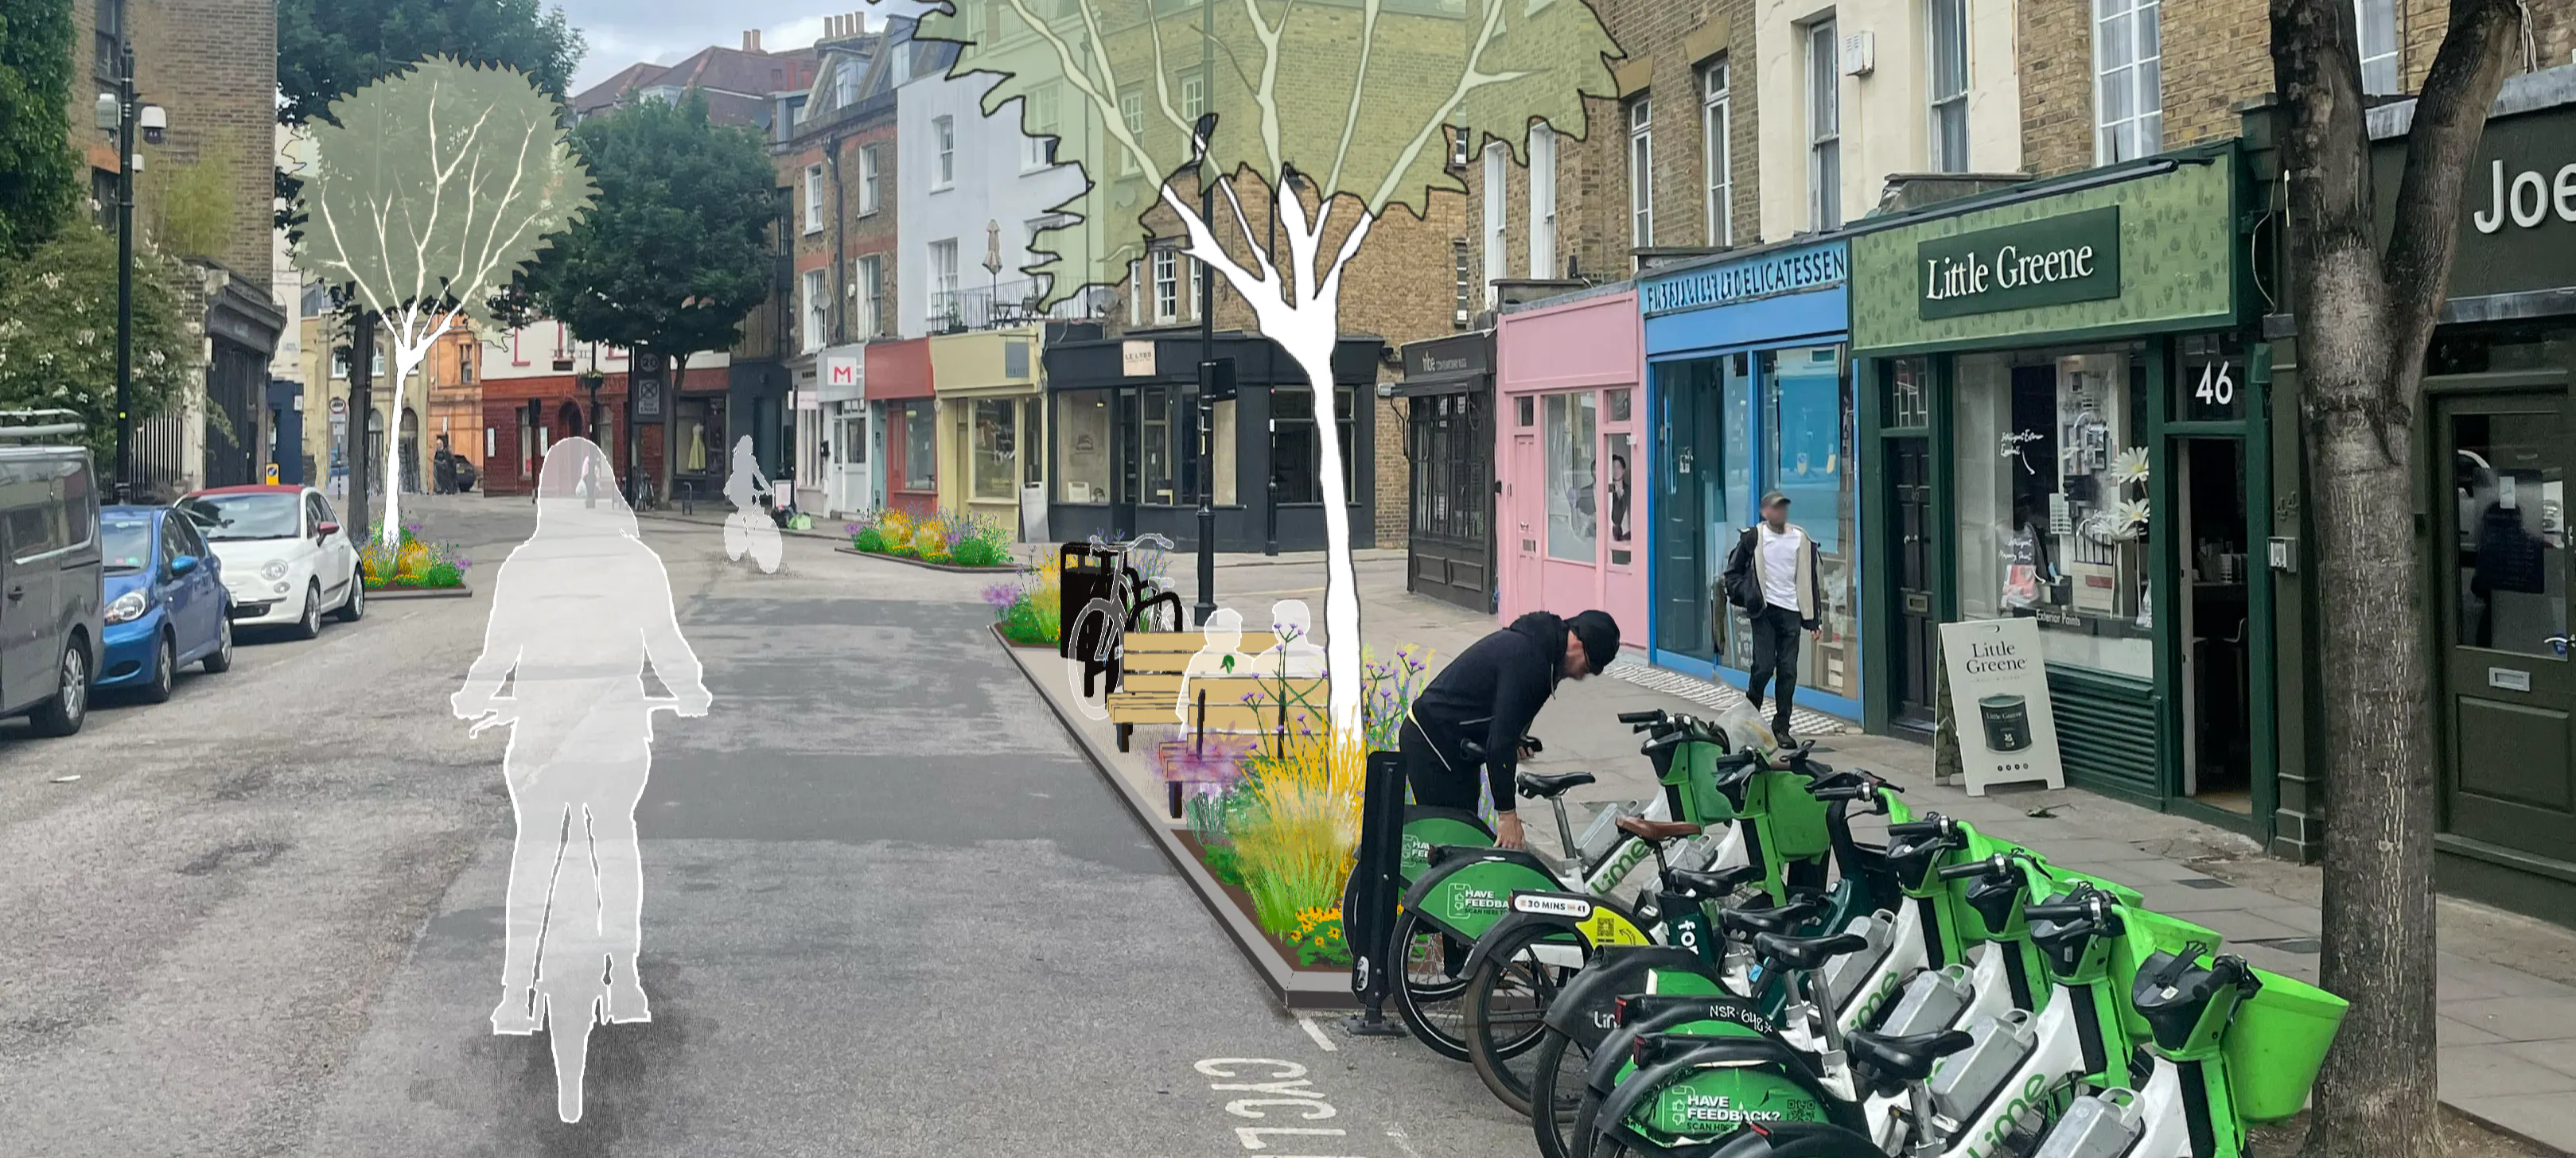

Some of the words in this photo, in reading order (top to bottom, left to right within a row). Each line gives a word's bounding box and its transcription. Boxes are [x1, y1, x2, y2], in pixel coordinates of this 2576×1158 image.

[1735, 247, 1846, 297] DELICATESSEN
[1926, 251, 1989, 301] Little
[1997, 244, 2095, 290] Greene
[642, 356, 656, 366] 20
[833, 366, 851, 383] M
[2195, 359, 2234, 406] 46
[2036, 608, 2060, 623] Exterior
[2061, 612, 2081, 627] Paints
[1971, 640, 2015, 658] Little
[1966, 659, 2027, 674] Greene
[1590, 839, 1648, 895] Lime
[1465, 889, 1495, 899] HAVE
[1542, 900, 1566, 911] MINS
[1193, 1057, 1367, 1158] CYCL
[1687, 1095, 1729, 1107] HAVE
[1687, 1122, 1711, 1131] SCAN
